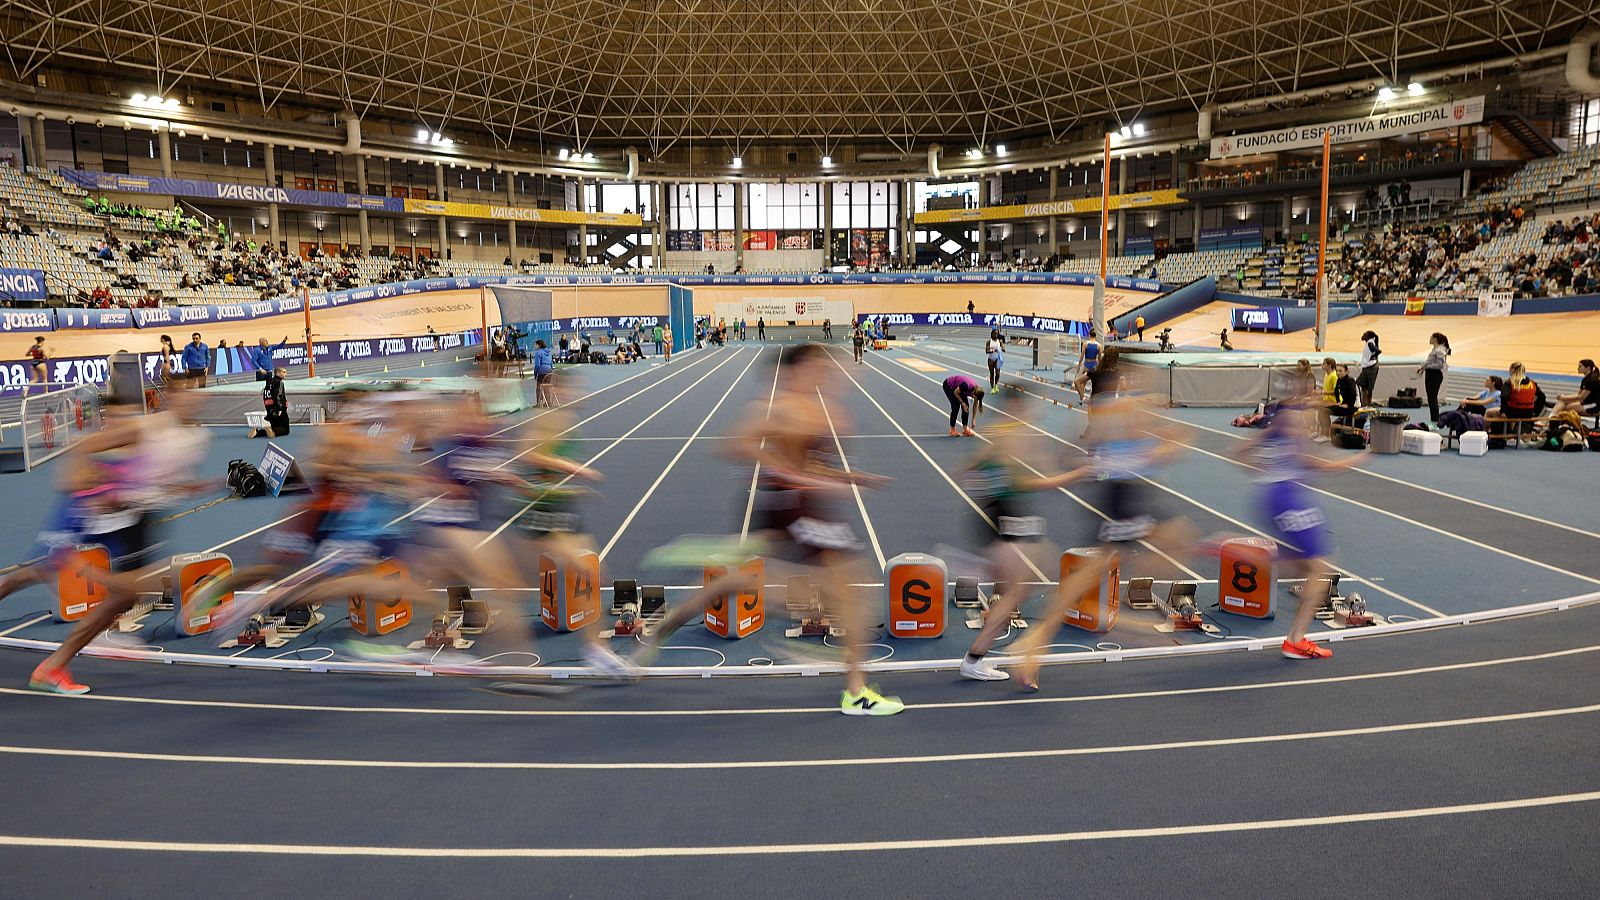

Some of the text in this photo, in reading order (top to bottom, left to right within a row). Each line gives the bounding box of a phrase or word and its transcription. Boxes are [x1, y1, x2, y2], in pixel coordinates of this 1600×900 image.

[1236, 128, 1297, 149] FUNDACIÓ
[1302, 121, 1374, 140] ESPORTIVA
[1379, 108, 1448, 130] MUNICIPAL
[217, 183, 289, 203] VALENCIA
[491, 206, 541, 221] VALENCIA
[1024, 201, 1075, 216] VALENCIA
[933, 274, 958, 282] enovis
[309, 294, 327, 307] oma
[272, 344, 328, 359] AMPEONATO SPAÑA
[76, 562, 95, 596] 1
[573, 572, 593, 600] 4
[1232, 560, 1258, 593] 8
[543, 570, 554, 608] 4
[902, 579, 931, 614] 6
